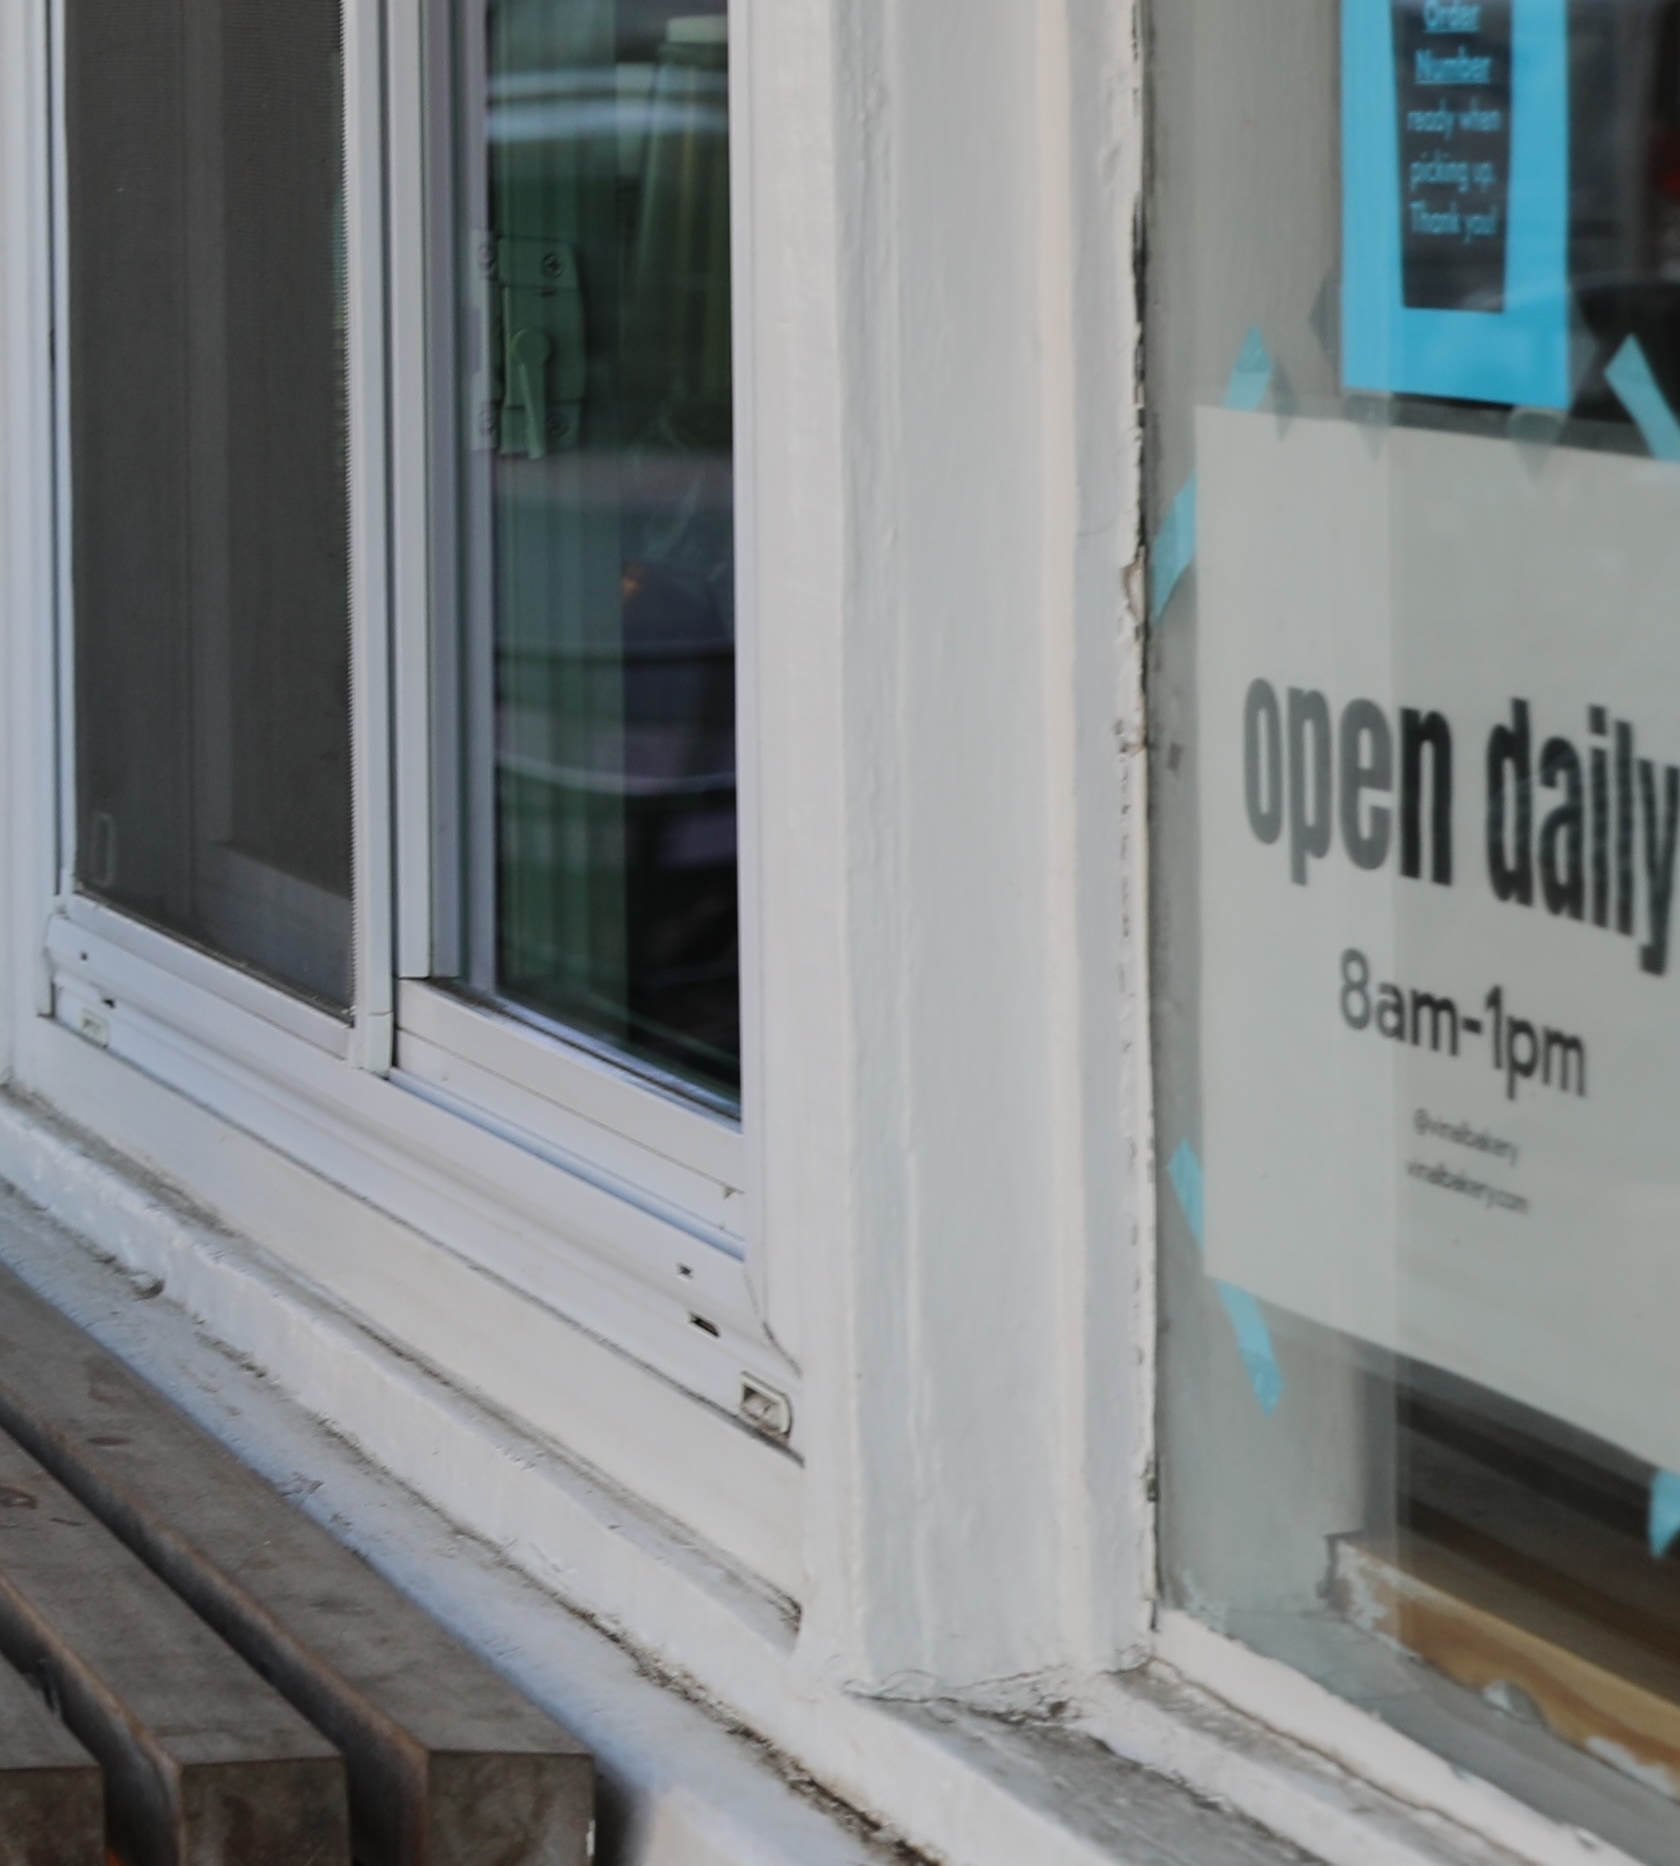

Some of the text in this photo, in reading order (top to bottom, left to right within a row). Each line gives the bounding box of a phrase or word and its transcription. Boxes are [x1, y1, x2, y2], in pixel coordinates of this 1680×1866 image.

[1415, 45, 1491, 83] Number
[1408, 97, 1501, 141] ready when
[1411, 148, 1469, 193] picking
[1409, 199, 1459, 234] Thank
[1243, 677, 1680, 976] open daily
[1340, 948, 1587, 1101] 8am-1pm
